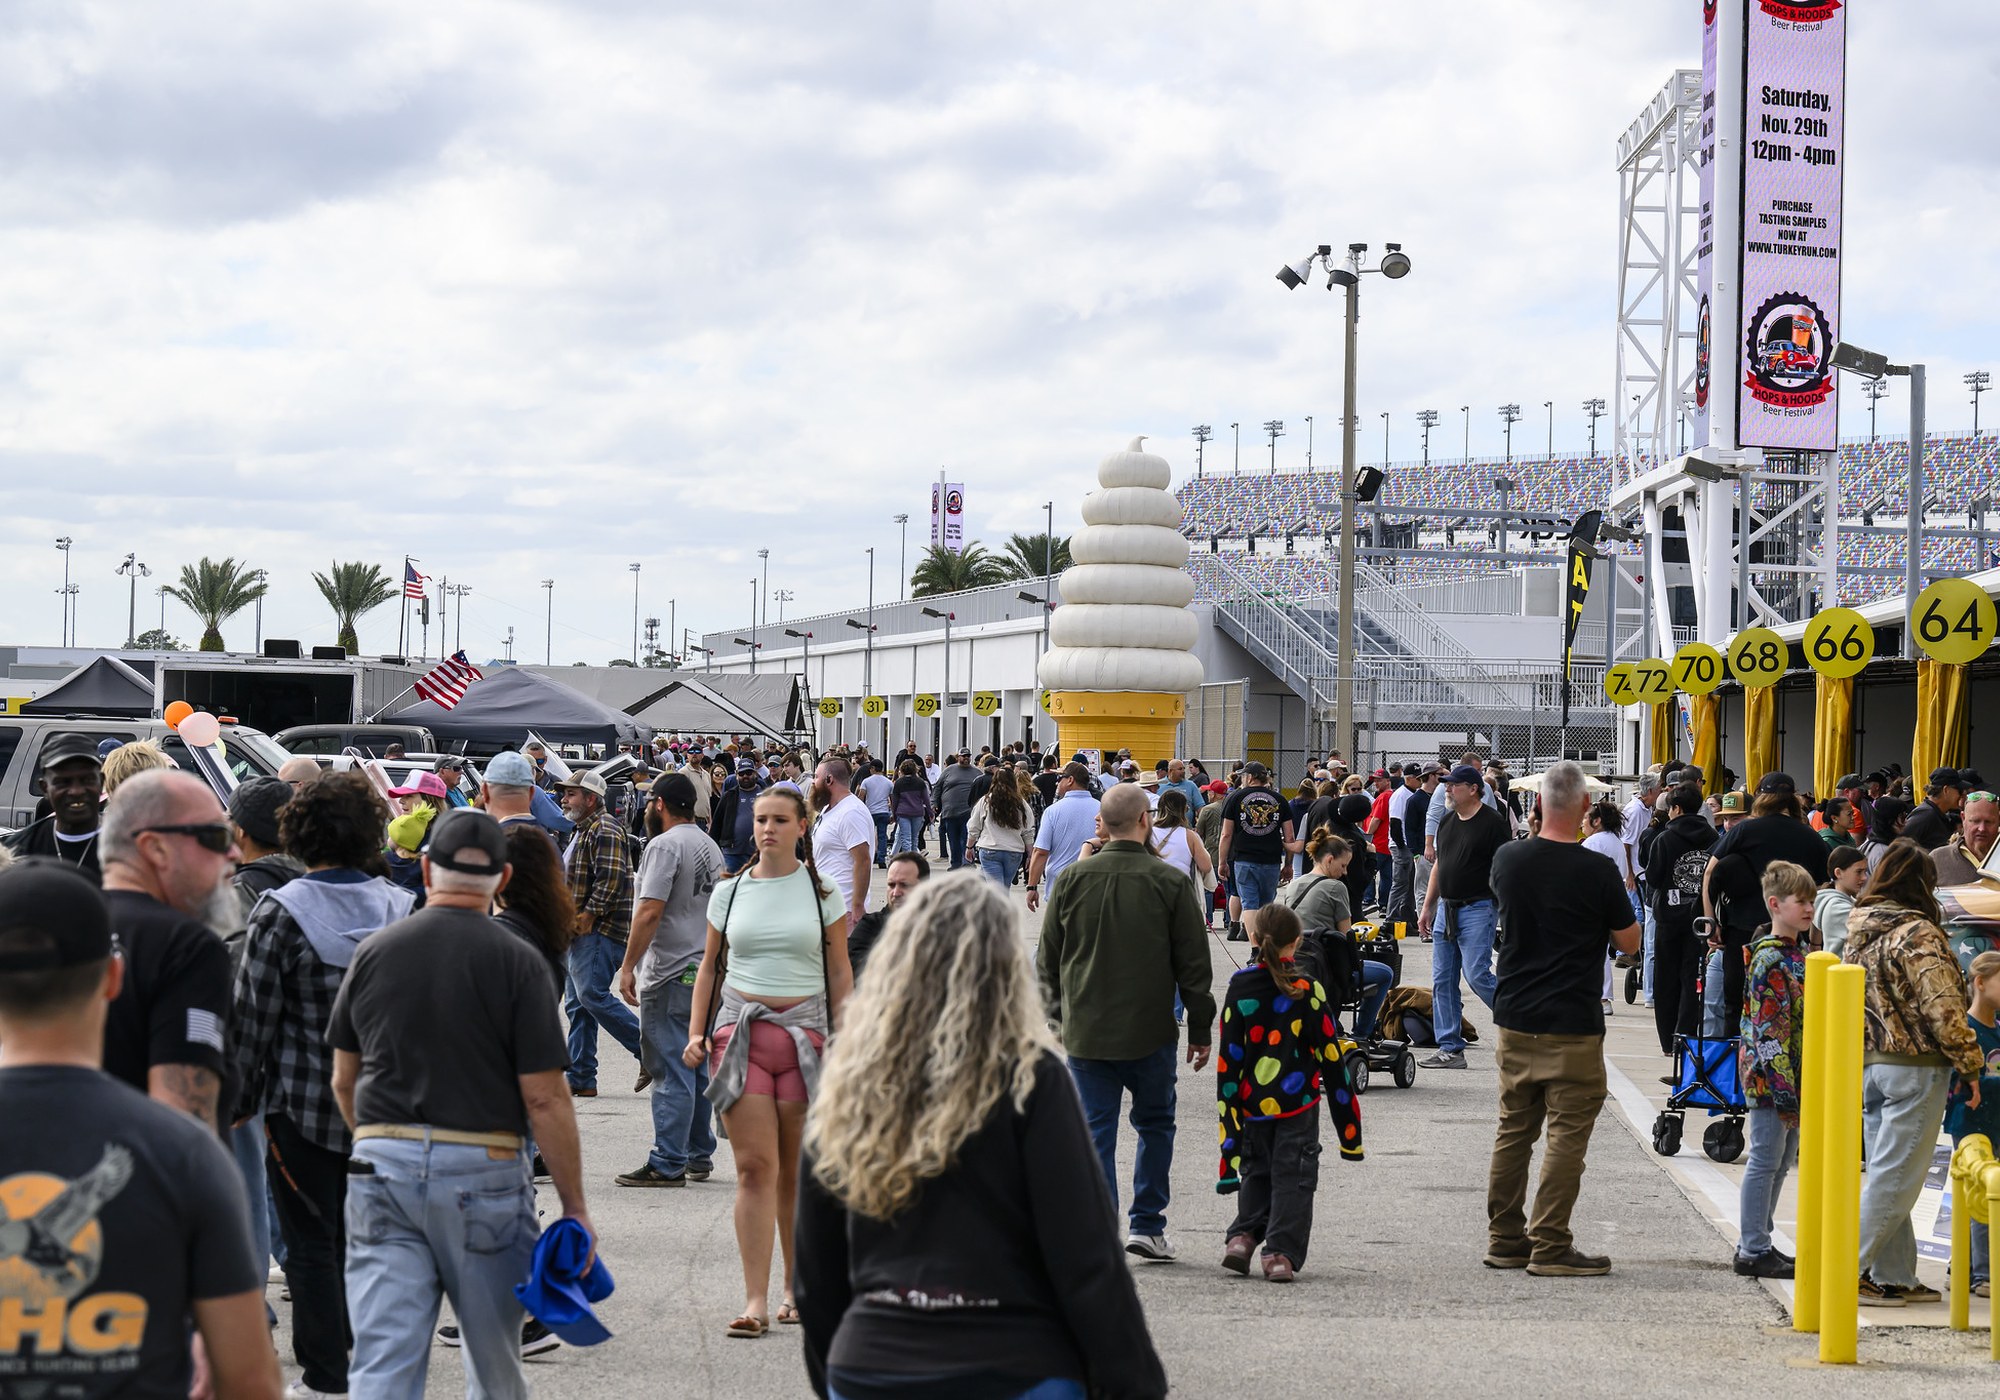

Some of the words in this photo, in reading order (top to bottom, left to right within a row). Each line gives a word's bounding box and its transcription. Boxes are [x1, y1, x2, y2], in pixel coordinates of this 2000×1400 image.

[1763, 3, 1788, 17] HOPS
[1790, 10, 1796, 18] &
[1798, 8, 1831, 20] HOODS
[1771, 16, 1790, 30] Beer
[1792, 20, 1823, 32] Festival
[1762, 85, 1832, 112] Saturday,
[1761, 114, 1791, 135] Nov.
[1794, 117, 1828, 137] 29th
[1752, 140, 1791, 162] 12pm
[1803, 145, 1836, 165] 4pm
[1772, 199, 1813, 213] PURCHASE
[1758, 213, 1791, 226] TASTING
[1792, 215, 1827, 229] SAMPLES
[1778, 229, 1797, 240] NOW
[1797, 231, 1807, 241] AT
[1747, 241, 1837, 259] WWW.TURKEYRUN.COM
[1754, 388, 1780, 403] HOPS
[1781, 394, 1788, 404] &
[1790, 392, 1823, 404] HOODS
[1762, 402, 1782, 416] Beer
[1784, 404, 1815, 417] Festival
[1919, 597, 1983, 643] 64
[1813, 623, 1865, 662] 66
[1736, 641, 1780, 673] 68
[1679, 656, 1715, 683] 70
[1636, 669, 1668, 693] 72
[821, 702, 836, 714] 33
[867, 700, 880, 713] 31
[917, 699, 934, 712] 29
[975, 696, 994, 710] 27
